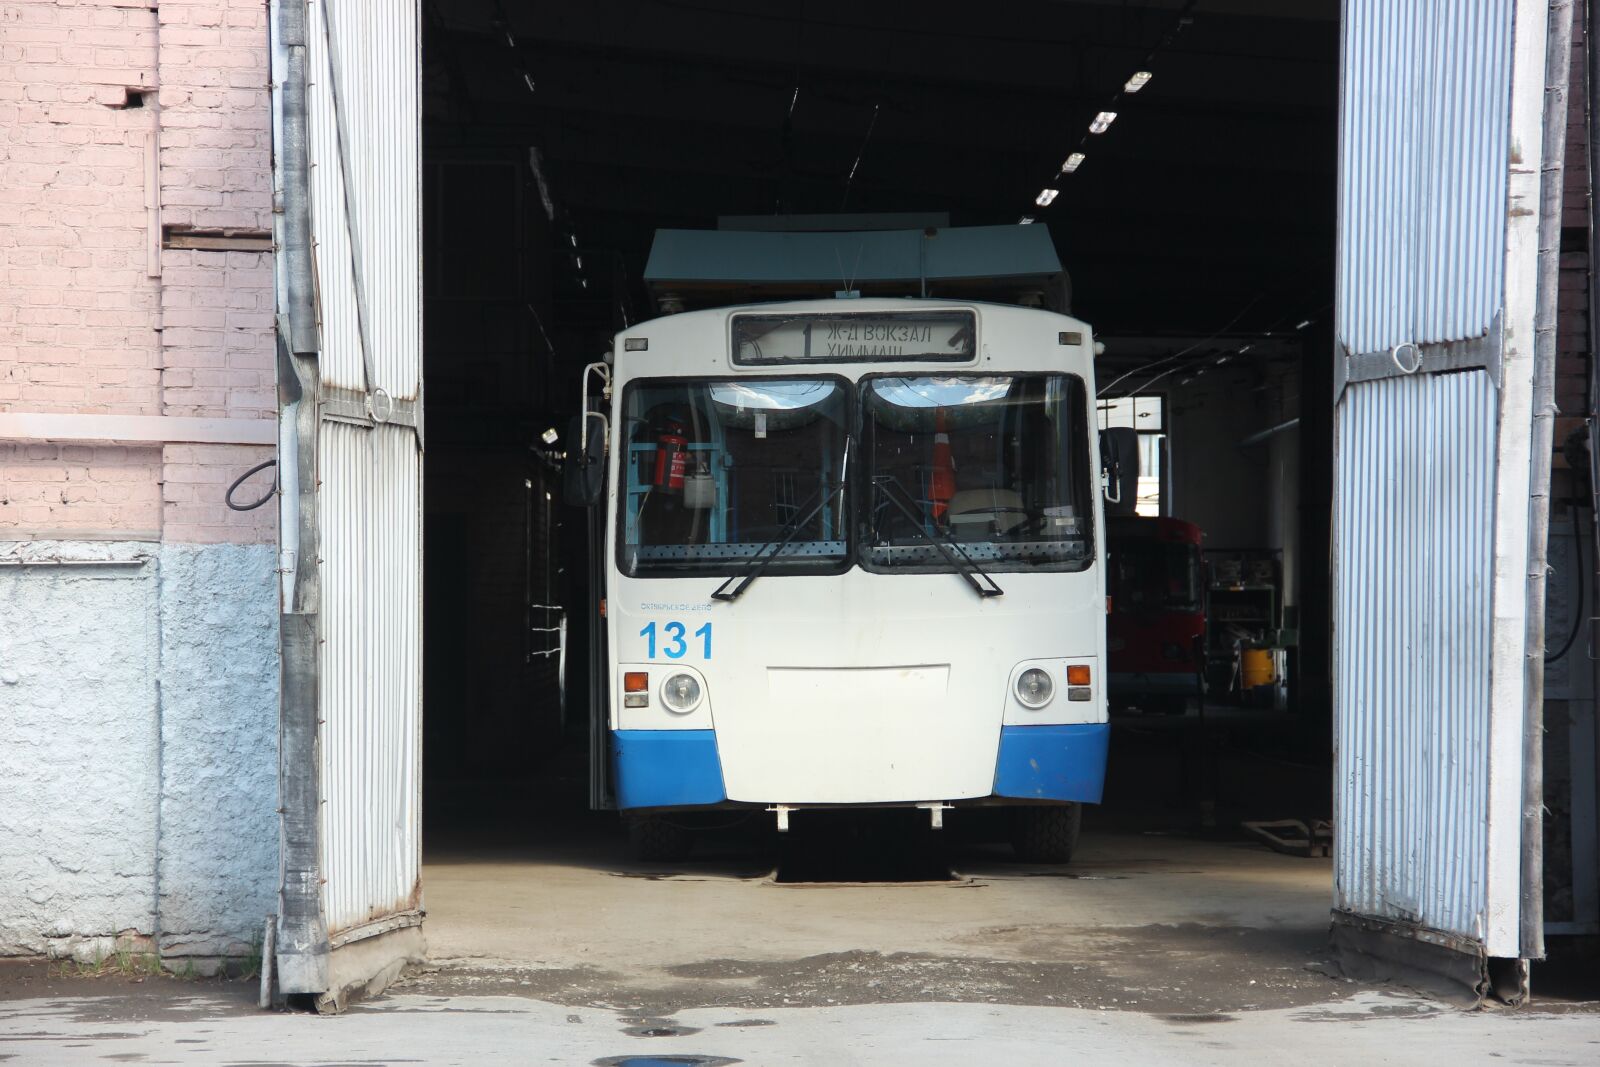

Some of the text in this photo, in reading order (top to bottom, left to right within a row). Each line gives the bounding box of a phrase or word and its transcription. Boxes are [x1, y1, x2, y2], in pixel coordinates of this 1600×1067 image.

[803, 324, 811, 357] 1
[863, 324, 932, 342] ВОКЗАЛ
[827, 343, 903, 356] ХИММАШ
[639, 621, 712, 660] 131
